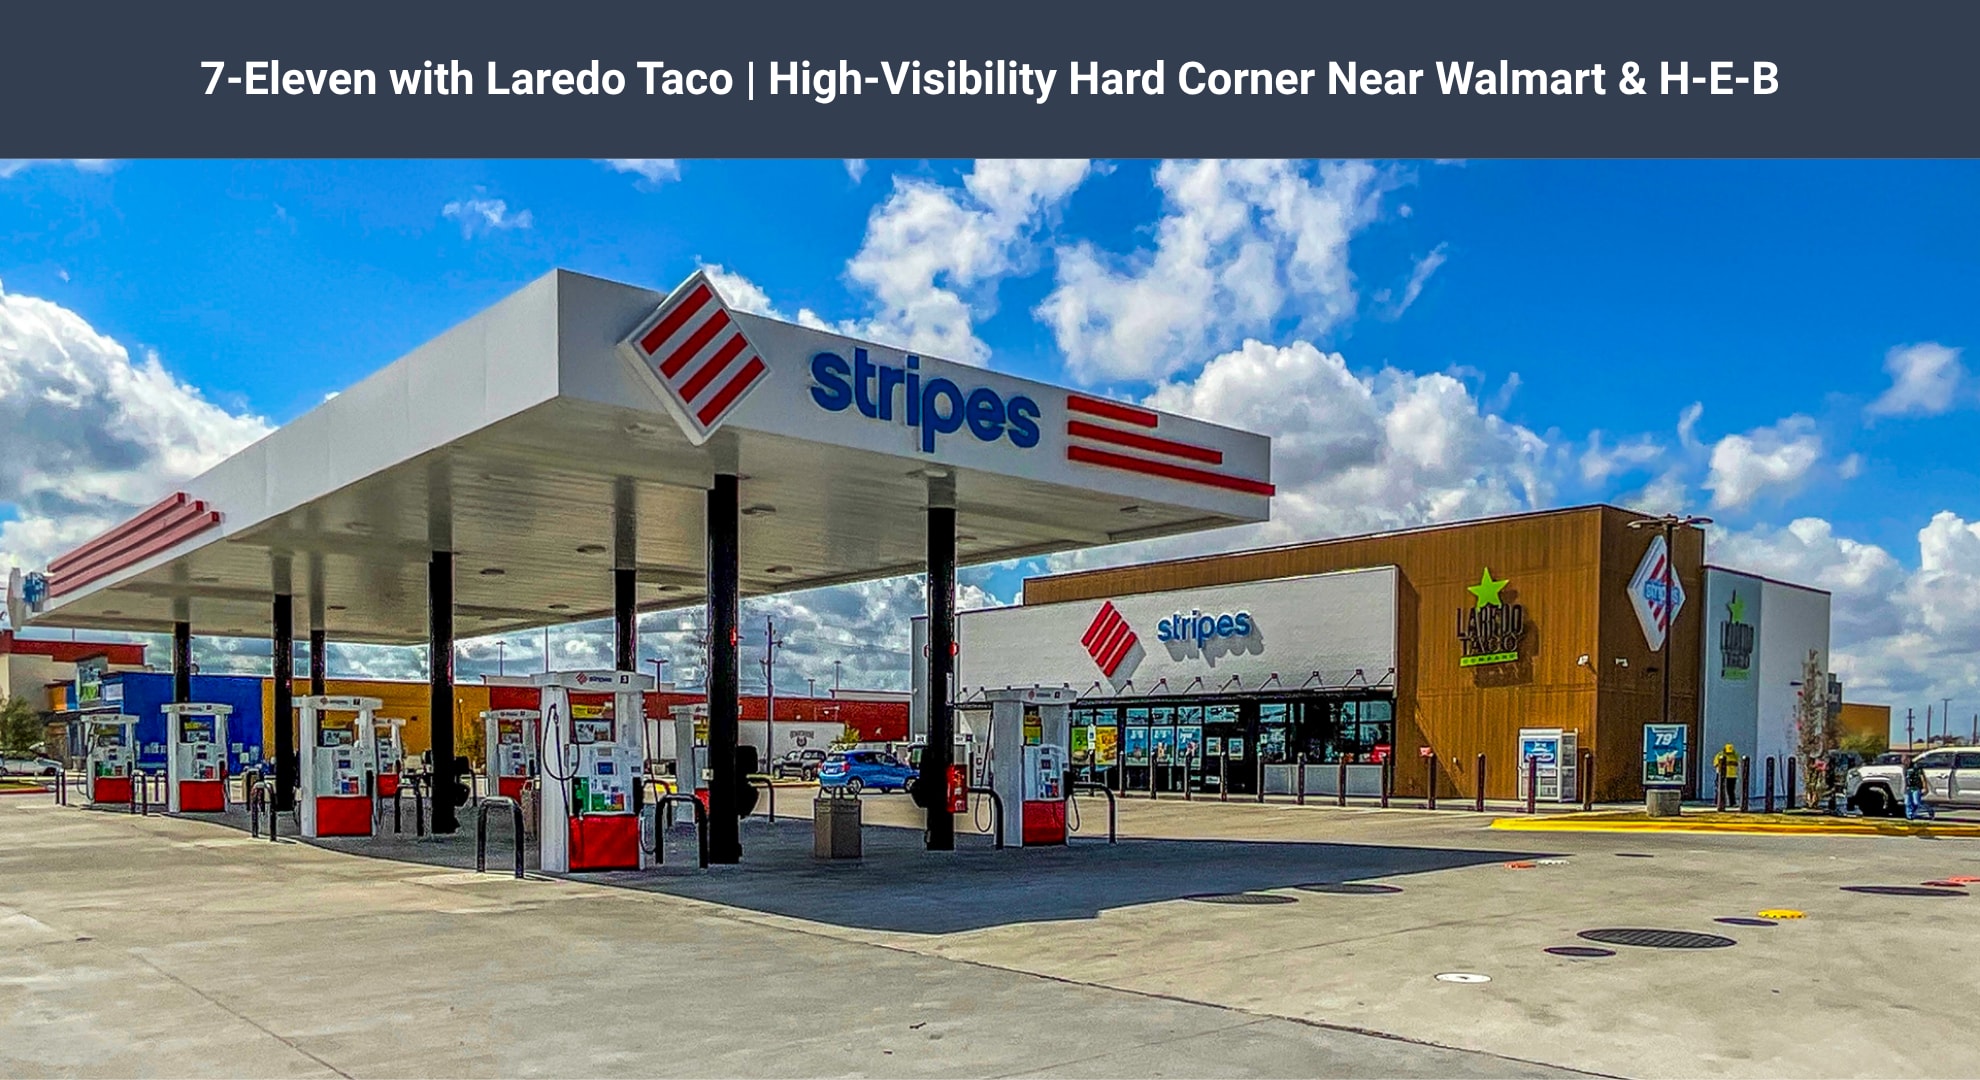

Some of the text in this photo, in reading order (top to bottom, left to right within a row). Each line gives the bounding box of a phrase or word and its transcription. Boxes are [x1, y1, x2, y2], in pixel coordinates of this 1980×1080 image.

[809, 346, 1041, 453] stripes
[1158, 610, 1250, 648] stripes
[1457, 603, 1524, 638] LAREDO
[1460, 633, 1519, 656] TACO
